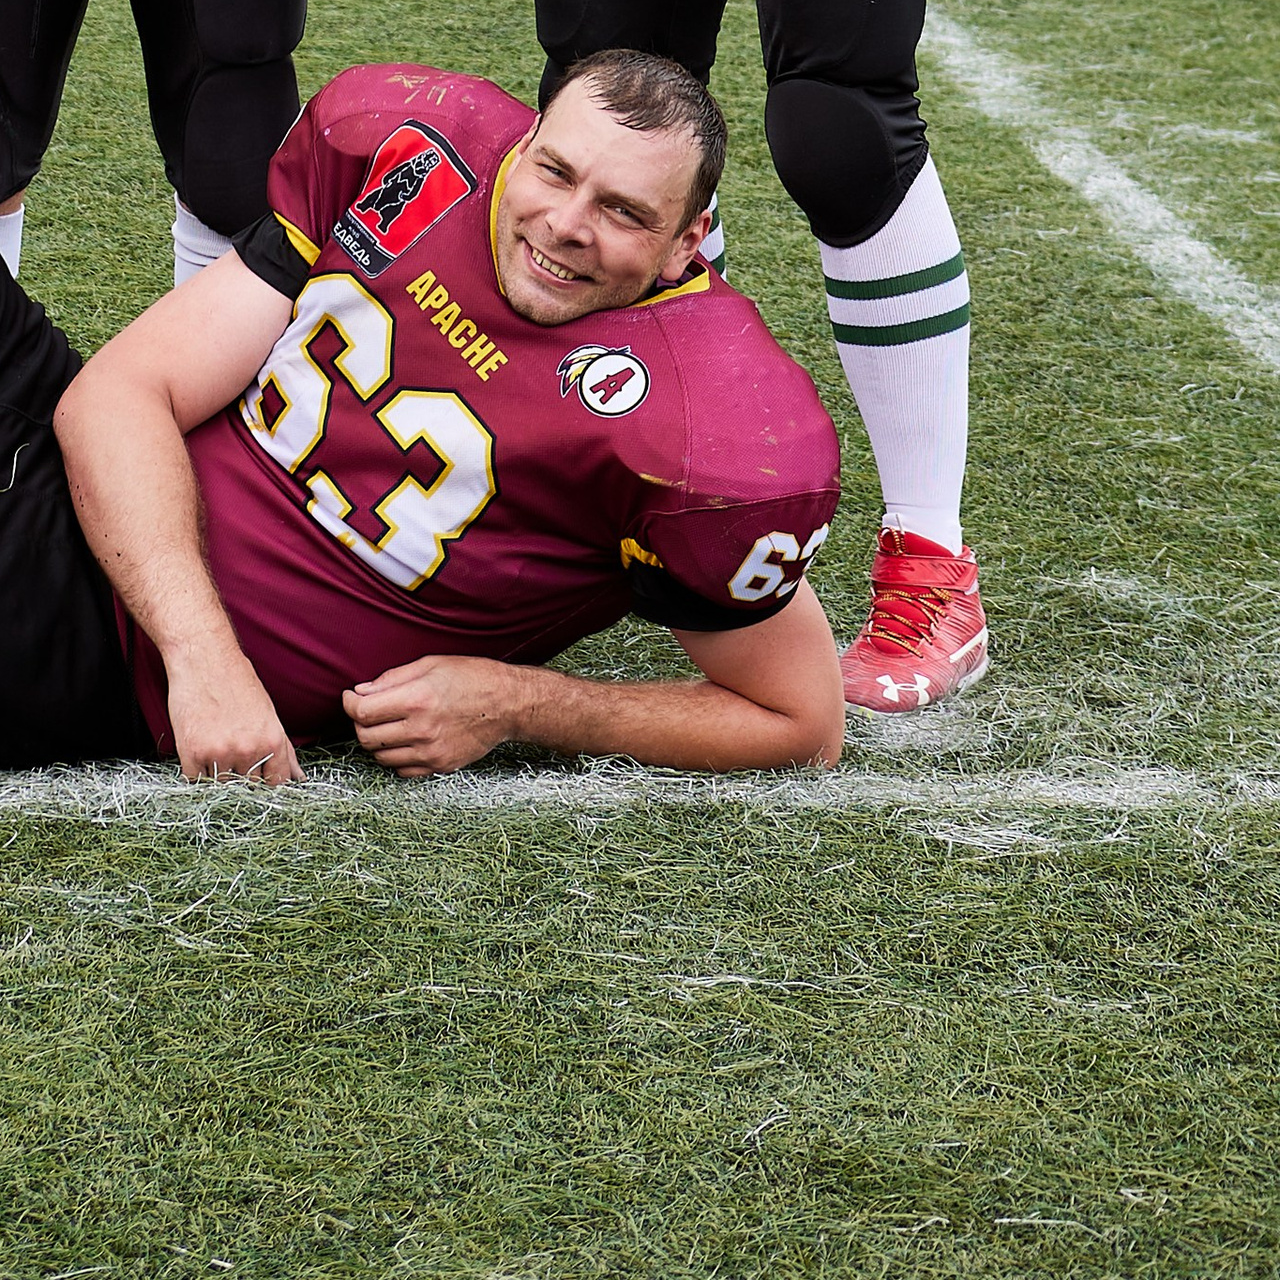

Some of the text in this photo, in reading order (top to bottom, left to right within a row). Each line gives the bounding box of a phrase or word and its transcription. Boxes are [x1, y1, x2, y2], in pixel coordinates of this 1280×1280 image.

[333, 221, 371, 267] ЕДВЕДЬ
[405, 269, 510, 382] APACHE
[589, 366, 636, 406] A
[229, 270, 500, 592] 63
